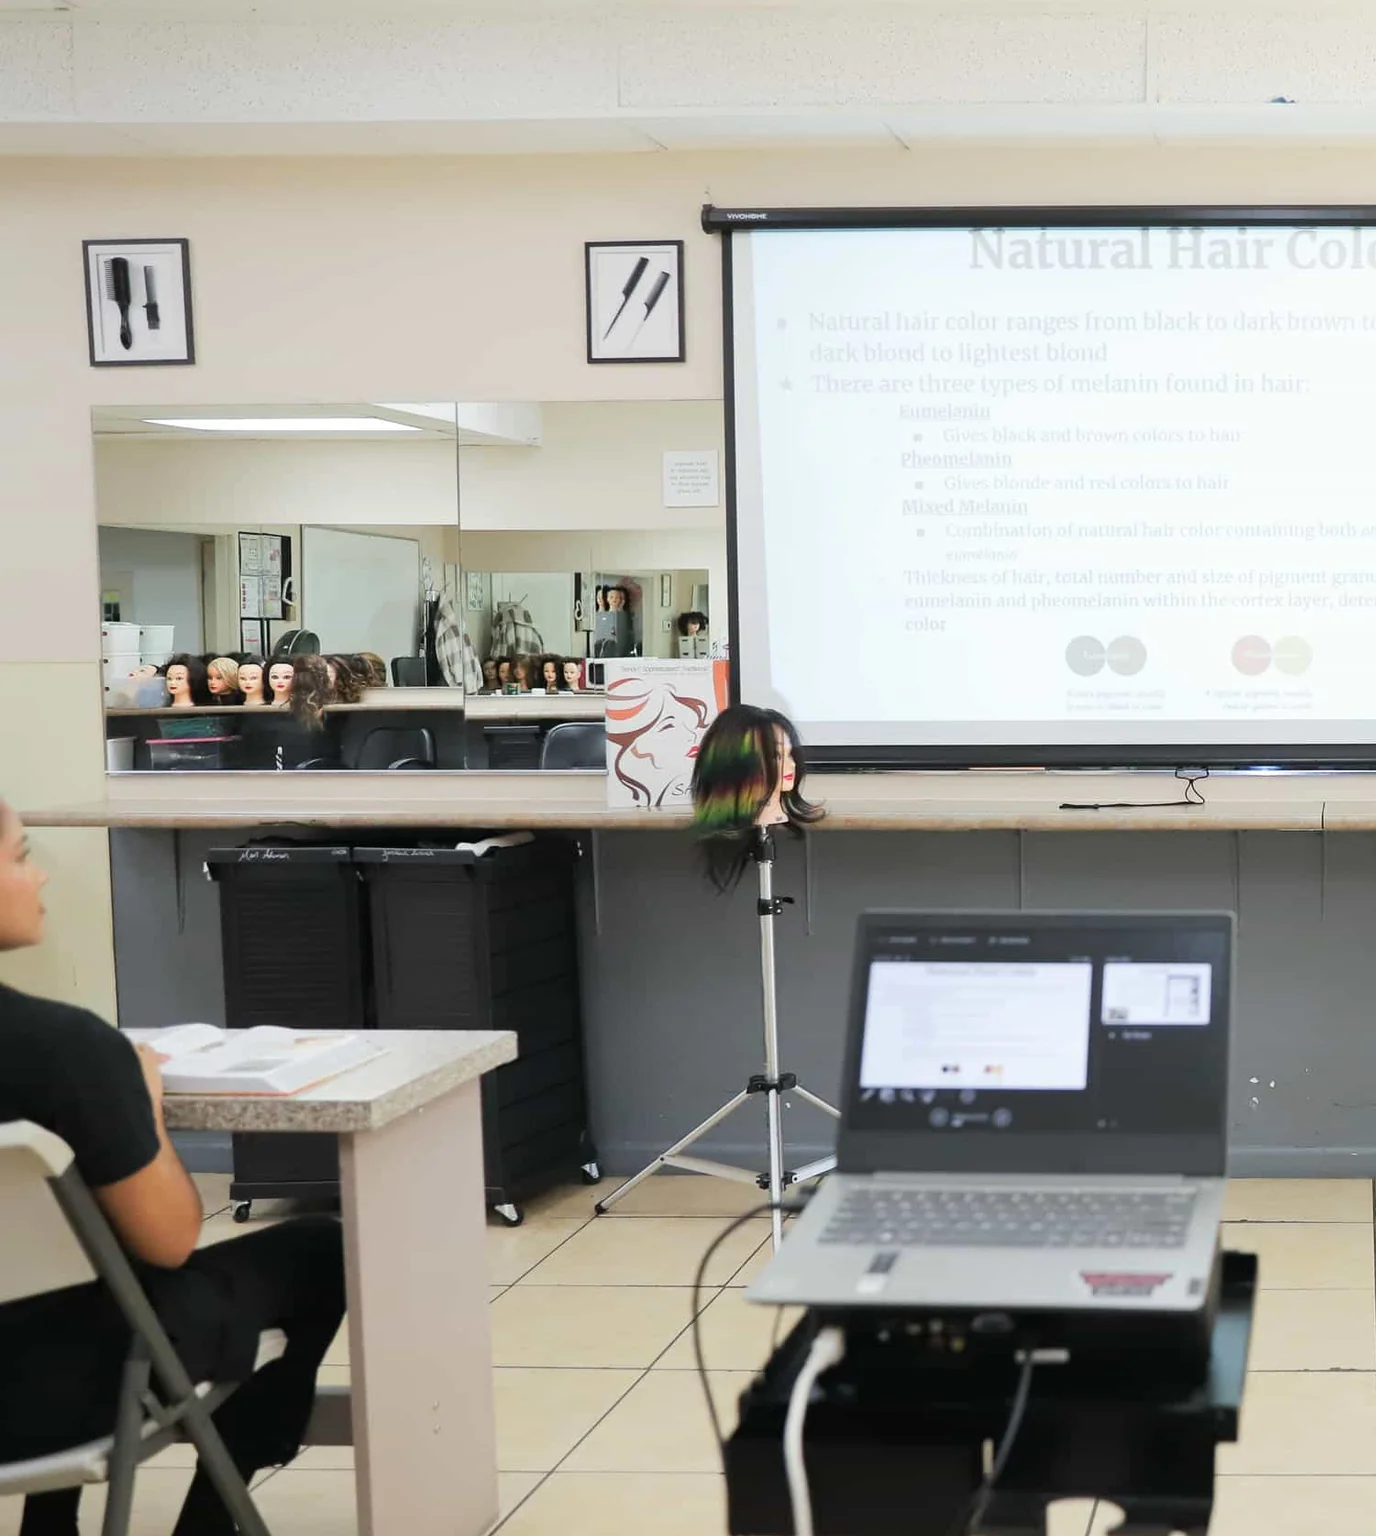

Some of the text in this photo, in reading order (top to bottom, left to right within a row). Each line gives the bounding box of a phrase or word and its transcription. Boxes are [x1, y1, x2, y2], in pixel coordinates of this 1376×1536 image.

[968, 227, 1152, 269] Natural
[1166, 227, 1275, 269] Hair
[809, 312, 890, 331] Natural
[896, 312, 938, 331] hair
[945, 312, 998, 331] color
[1006, 317, 1079, 336] ranges
[1086, 312, 1137, 331] from
[1143, 312, 1203, 331] black
[1207, 312, 1227, 331] to
[1233, 312, 1286, 331] dark
[1288, 312, 1356, 331] brown
[810, 343, 1108, 367] dark blond to lightest blond
[811, 374, 1310, 398] There are three types of melanin found in hair:
[899, 403, 992, 420] Eumelanin
[943, 428, 988, 442] Gives
[992, 428, 1036, 442] black
[1041, 428, 1071, 442] and
[1076, 428, 1129, 442] brown
[1133, 428, 1184, 442] colors
[1188, 428, 1206, 442] to
[901, 451, 1013, 469] Pheomelanin
[944, 476, 1231, 490] Gives blonde and red colors to hair
[902, 499, 1029, 515] Mixed Melanin
[946, 523, 1053, 538] Combination
[1057, 523, 1072, 538] of
[1079, 523, 1138, 538] natural
[1142, 523, 1175, 538] hair
[1180, 523, 1225, 538] color
[1226, 523, 1316, 542] containing
[1319, 523, 1357, 538] both
[904, 570, 988, 585] Thickness
[992, 570, 1008, 585] of
[1013, 570, 1050, 587] hair,
[1056, 570, 1093, 585] total
[1098, 570, 1161, 585] number
[1166, 570, 1197, 585] and
[1202, 570, 1234, 585] size
[1238, 570, 1256, 585] of
[1259, 570, 1327, 589] pigment
[905, 594, 992, 608] eumelanin
[996, 594, 1027, 608] and
[1032, 594, 1139, 612] pheomelanin
[1144, 594, 1196, 608] within
[1202, 594, 1228, 608] the
[1232, 594, 1284, 608] cortex
[1288, 594, 1333, 612] layer,
[905, 617, 947, 632] color
